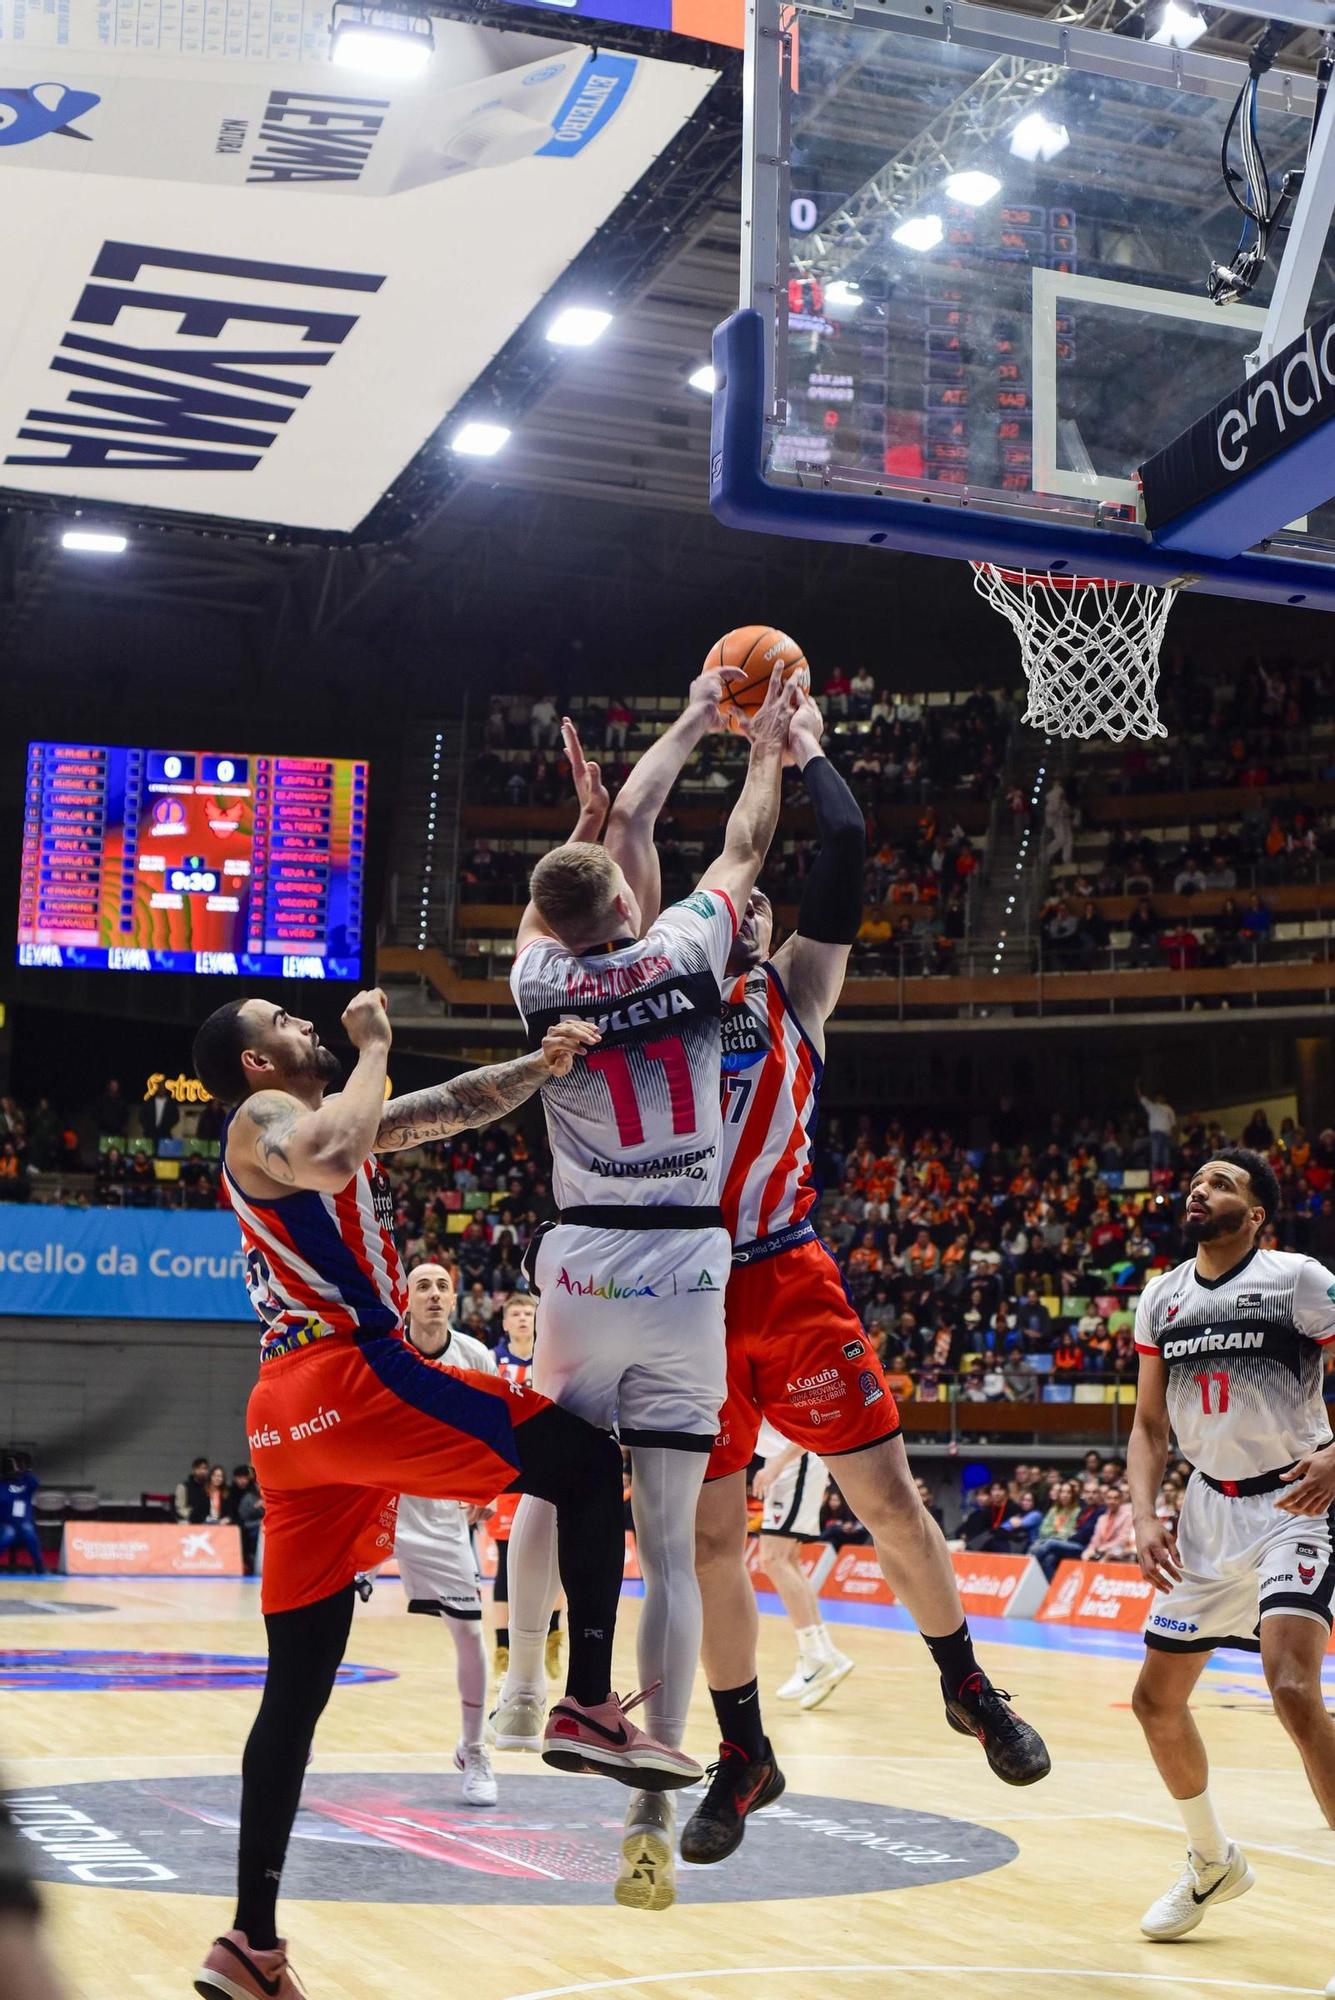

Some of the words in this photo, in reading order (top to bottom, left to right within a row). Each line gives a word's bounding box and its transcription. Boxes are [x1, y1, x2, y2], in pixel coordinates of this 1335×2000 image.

[553, 74, 619, 144] ENTEIRO
[214, 118, 249, 155] NATURA
[246, 89, 391, 184] LEYMA
[3, 239, 388, 471] LEYMA
[164, 756, 182, 778] 0
[217, 761, 235, 782] 0
[19, 944, 63, 966] LEYMA
[108, 948, 151, 970] LEYMA
[195, 952, 239, 975] LEYMA
[282, 956, 326, 979] LEYMA
[566, 954, 673, 998] VALTONEN
[585, 1036, 697, 1148] 11
[720, 1076, 753, 1125] 7
[96, 1245, 139, 1277] da
[149, 1248, 249, 1280] Coruñ
[556, 1266, 660, 1299] Andalucía
[847, 1347, 861, 1359] acb
[786, 1382, 798, 1393] A
[796, 1368, 839, 1389] Coruña
[808, 1380, 847, 1397] PROVINCIA
[807, 1387, 847, 1406] DESCUBRIR
[289, 1405, 341, 1441] ancín
[1298, 1546, 1315, 1556] acb
[1153, 1615, 1188, 1633] asisa
